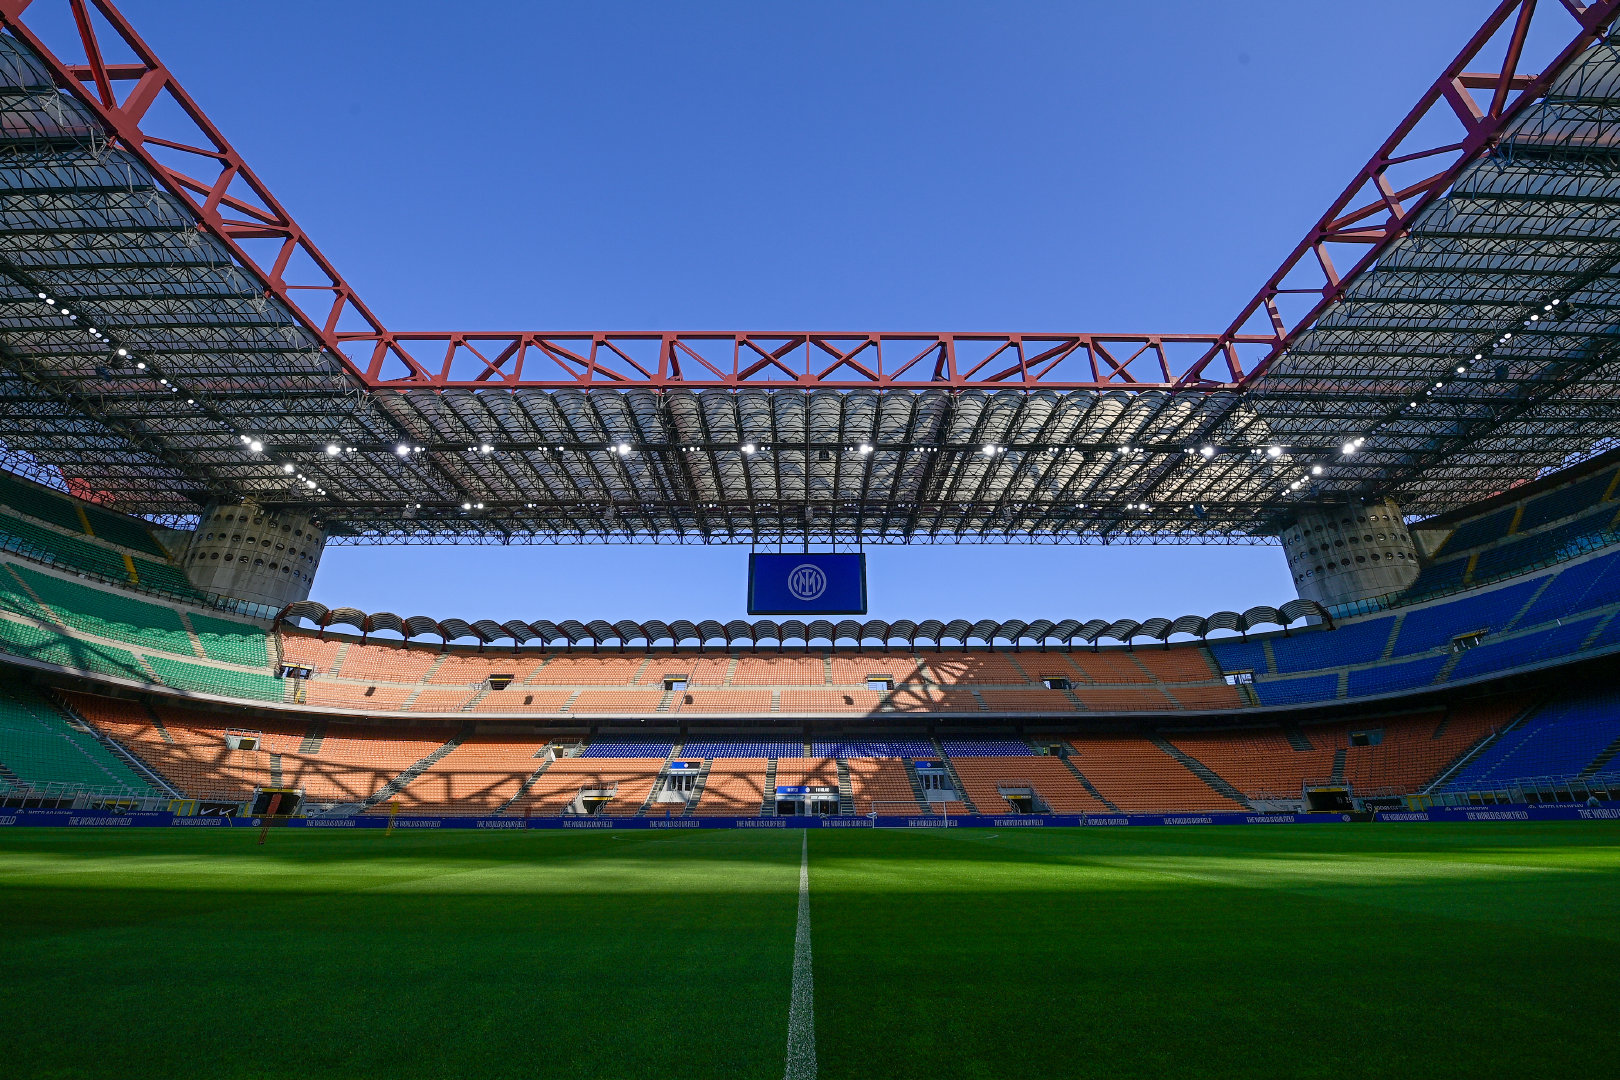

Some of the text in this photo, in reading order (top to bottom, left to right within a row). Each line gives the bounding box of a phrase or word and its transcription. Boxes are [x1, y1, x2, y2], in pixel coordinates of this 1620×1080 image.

[1466, 811, 1476, 820] THE
[1476, 811, 1495, 820] WORLD
[1501, 811, 1512, 820] OUR
[1512, 811, 1528, 820] FIELD
[1578, 810, 1593, 818] THE
[1591, 808, 1618, 818] WORLD
